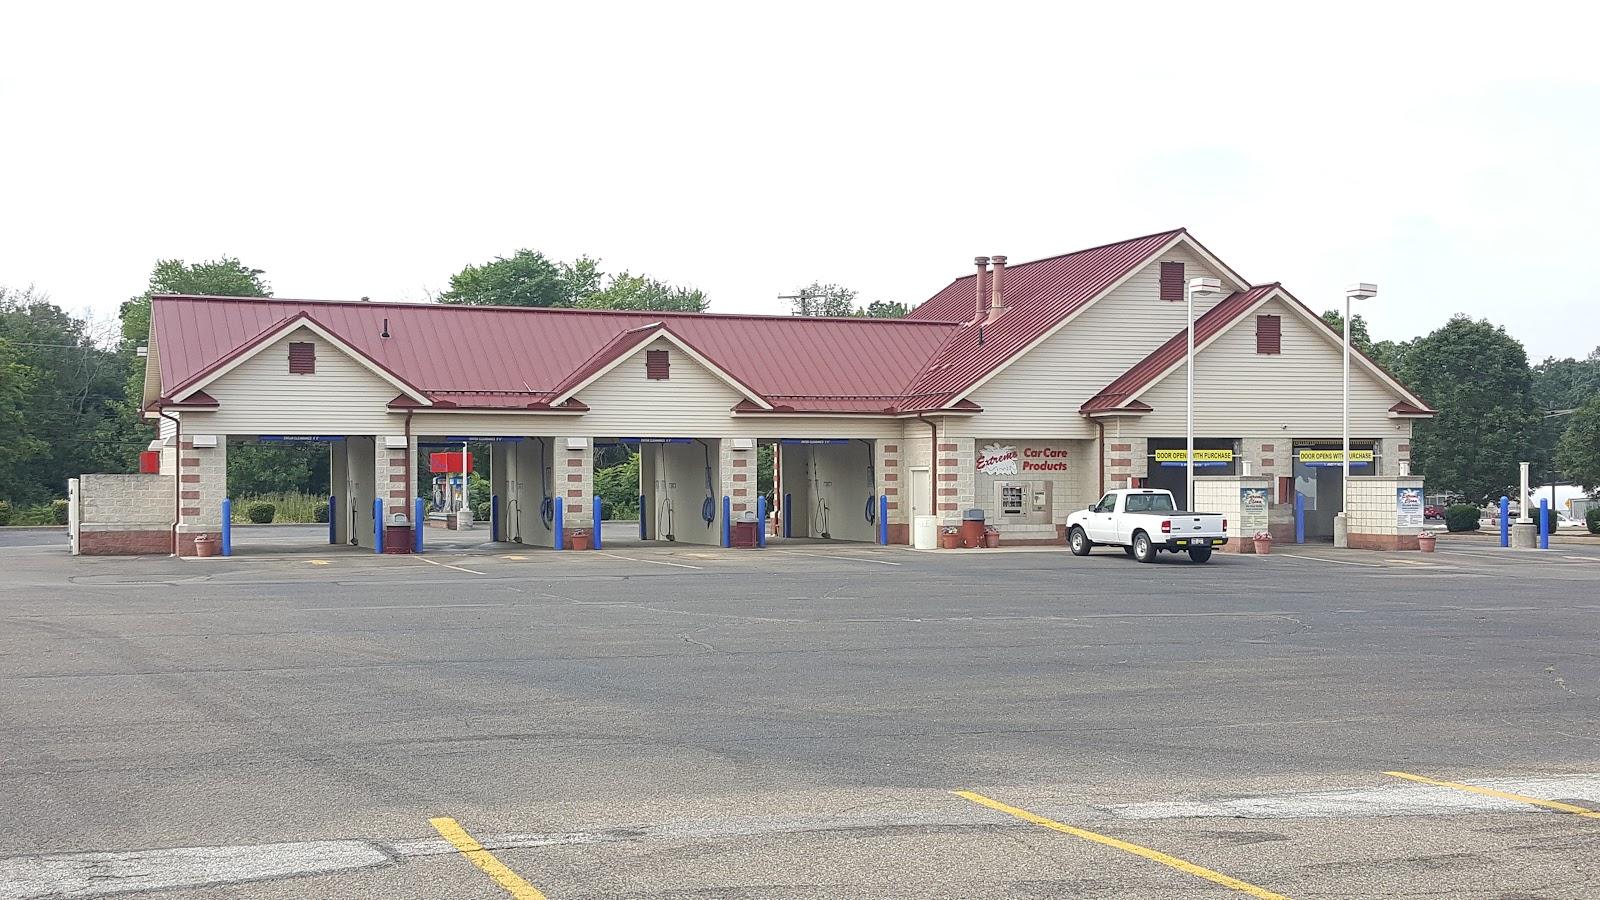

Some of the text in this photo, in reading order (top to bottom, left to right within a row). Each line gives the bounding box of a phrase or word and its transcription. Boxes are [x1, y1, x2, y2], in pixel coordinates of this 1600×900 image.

[1043, 448, 1068, 458] Care
[976, 451, 1018, 470] Extreme
[1022, 460, 1067, 471] Products
